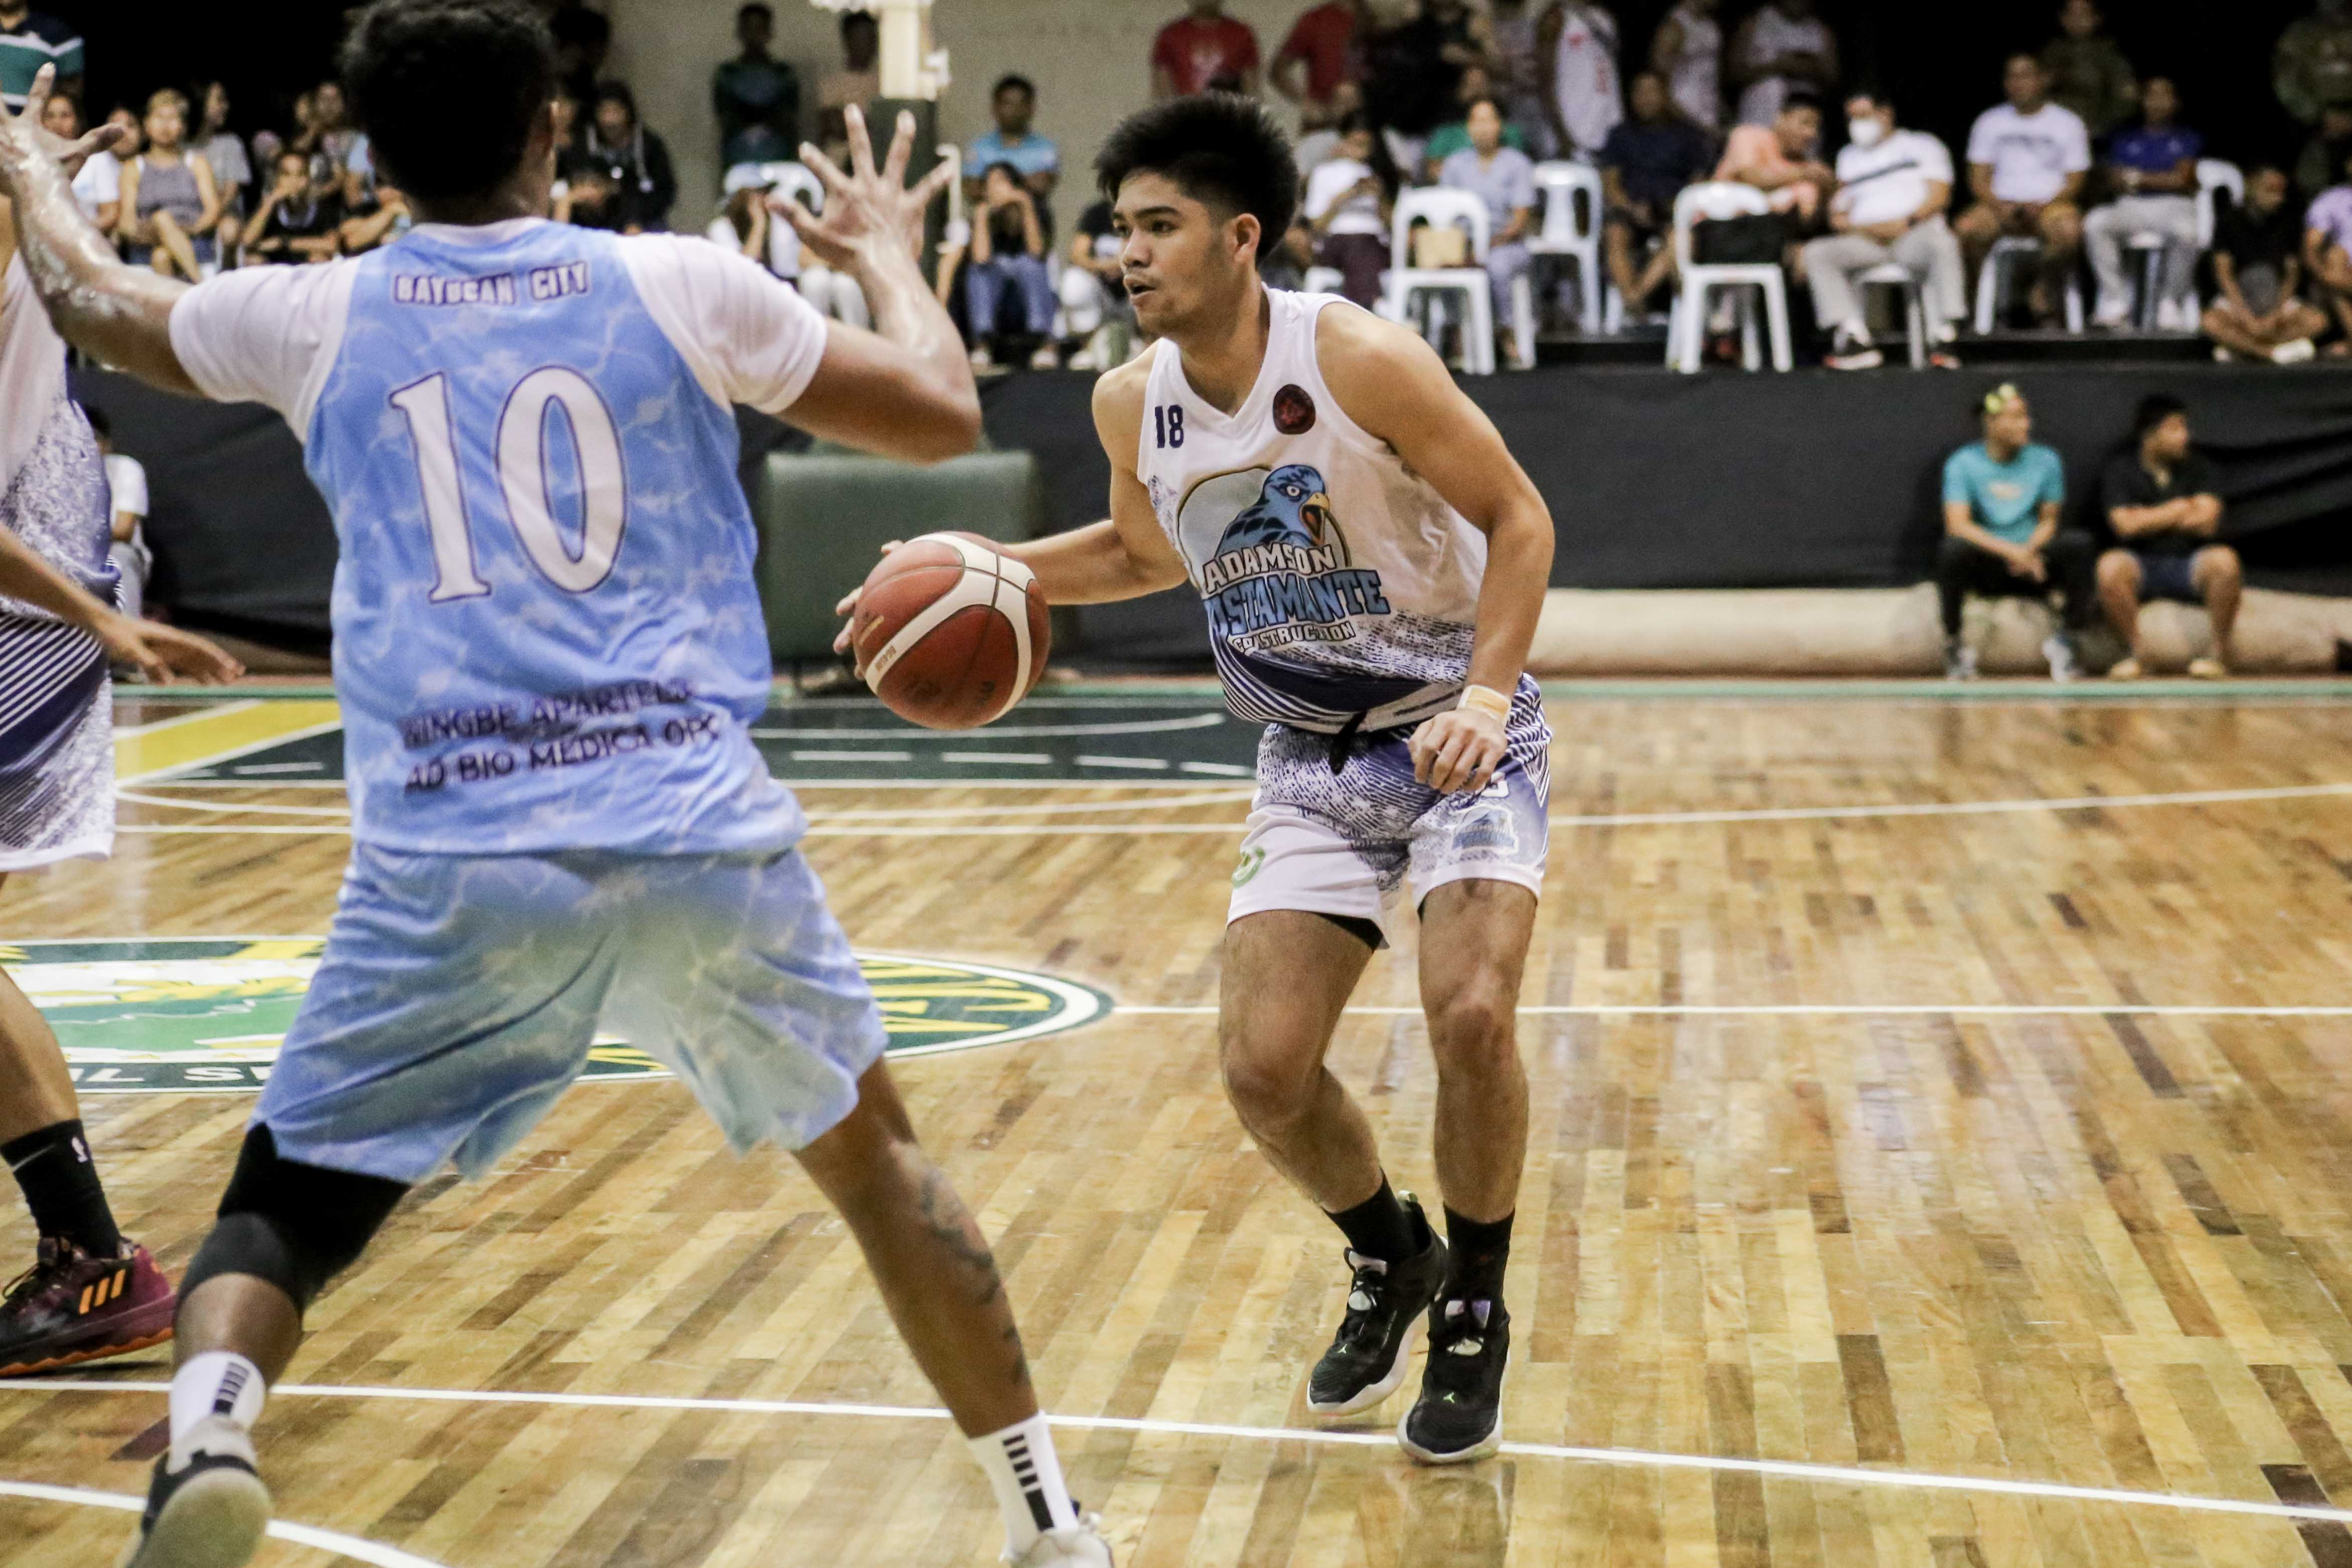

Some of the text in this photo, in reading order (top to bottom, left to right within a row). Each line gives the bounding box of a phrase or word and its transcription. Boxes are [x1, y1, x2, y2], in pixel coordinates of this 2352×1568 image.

[529, 260, 587, 301] CITY
[1154, 404, 1184, 448] 18
[388, 363, 627, 603] 10
[1202, 541, 1338, 595] ADAMSON
[458, 750, 515, 781] BIO
